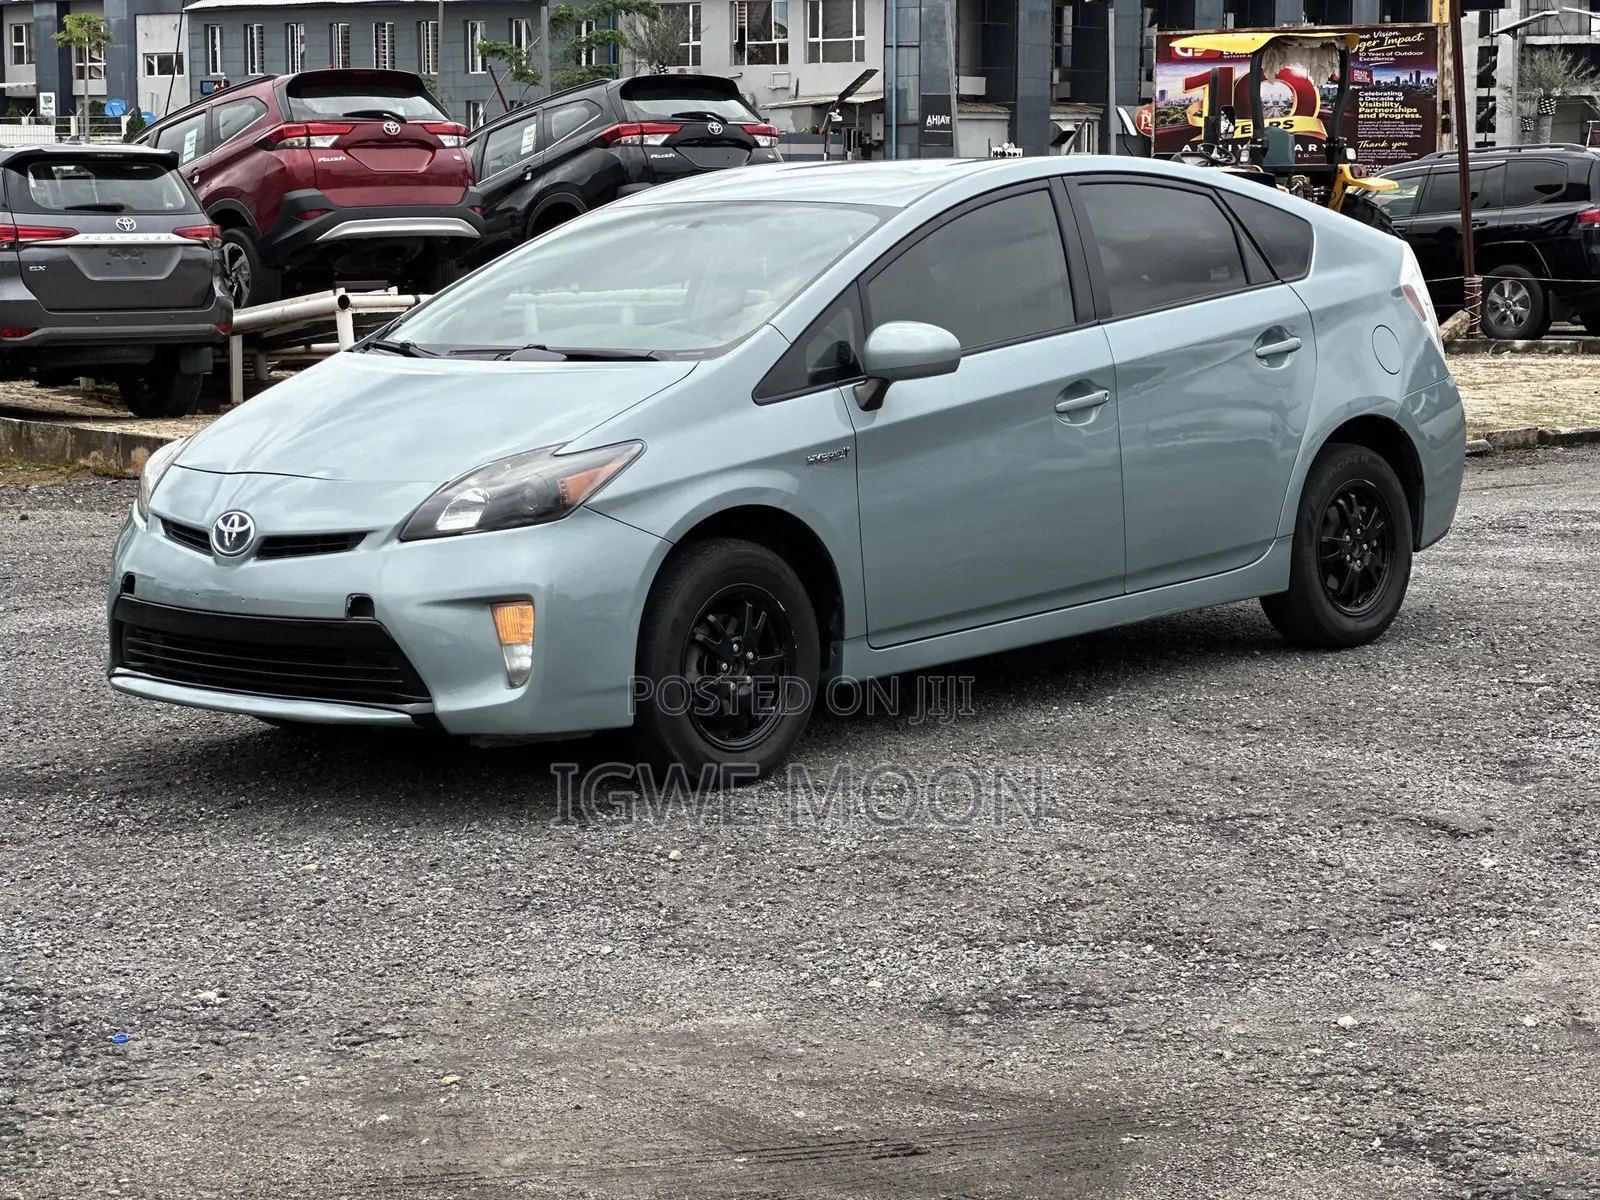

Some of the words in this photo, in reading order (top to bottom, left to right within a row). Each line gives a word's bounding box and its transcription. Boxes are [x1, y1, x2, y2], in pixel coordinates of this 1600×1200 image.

[1383, 32, 1425, 47] Impact.
[1358, 106, 1418, 114] Partnerships
[1357, 140, 1389, 149] Thank
[1391, 141, 1409, 150] you
